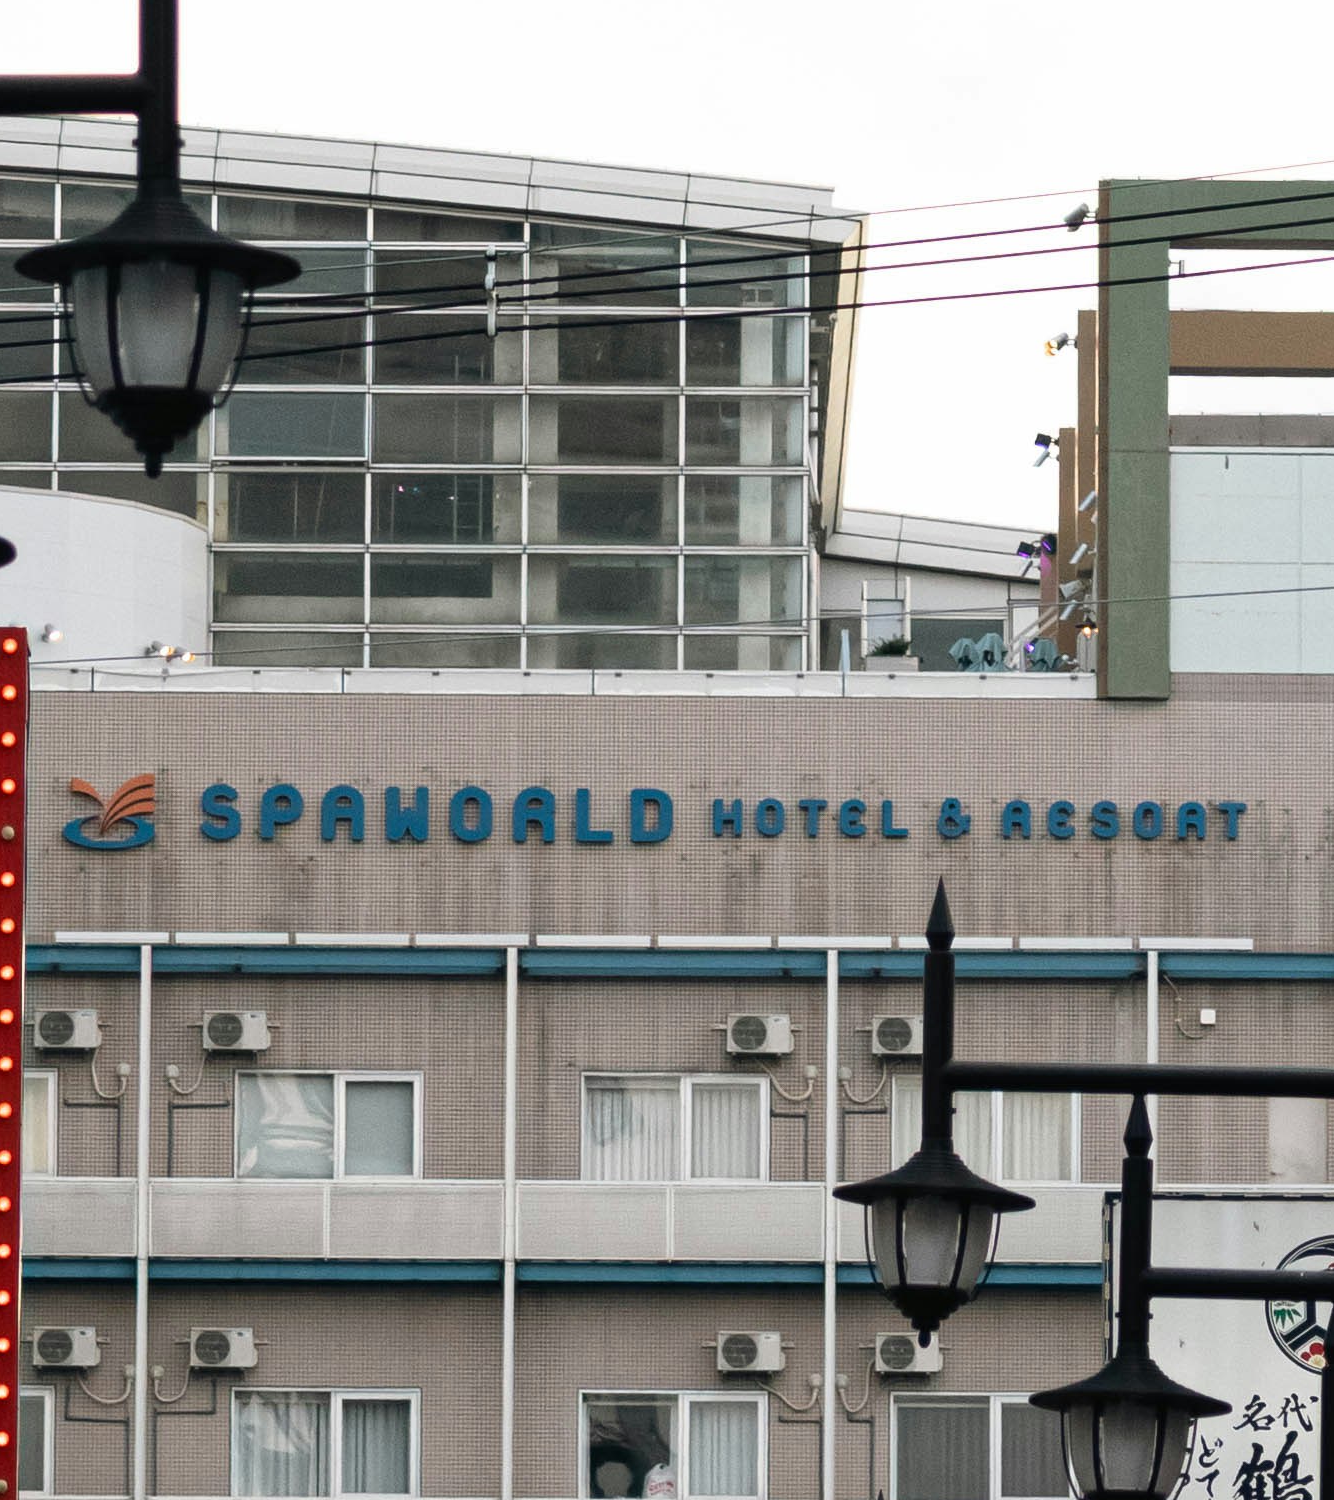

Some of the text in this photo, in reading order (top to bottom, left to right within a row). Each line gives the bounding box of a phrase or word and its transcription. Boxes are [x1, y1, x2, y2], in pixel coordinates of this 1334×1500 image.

[199, 782, 1250, 846] SPAWORLD HOTEL & RESORT
